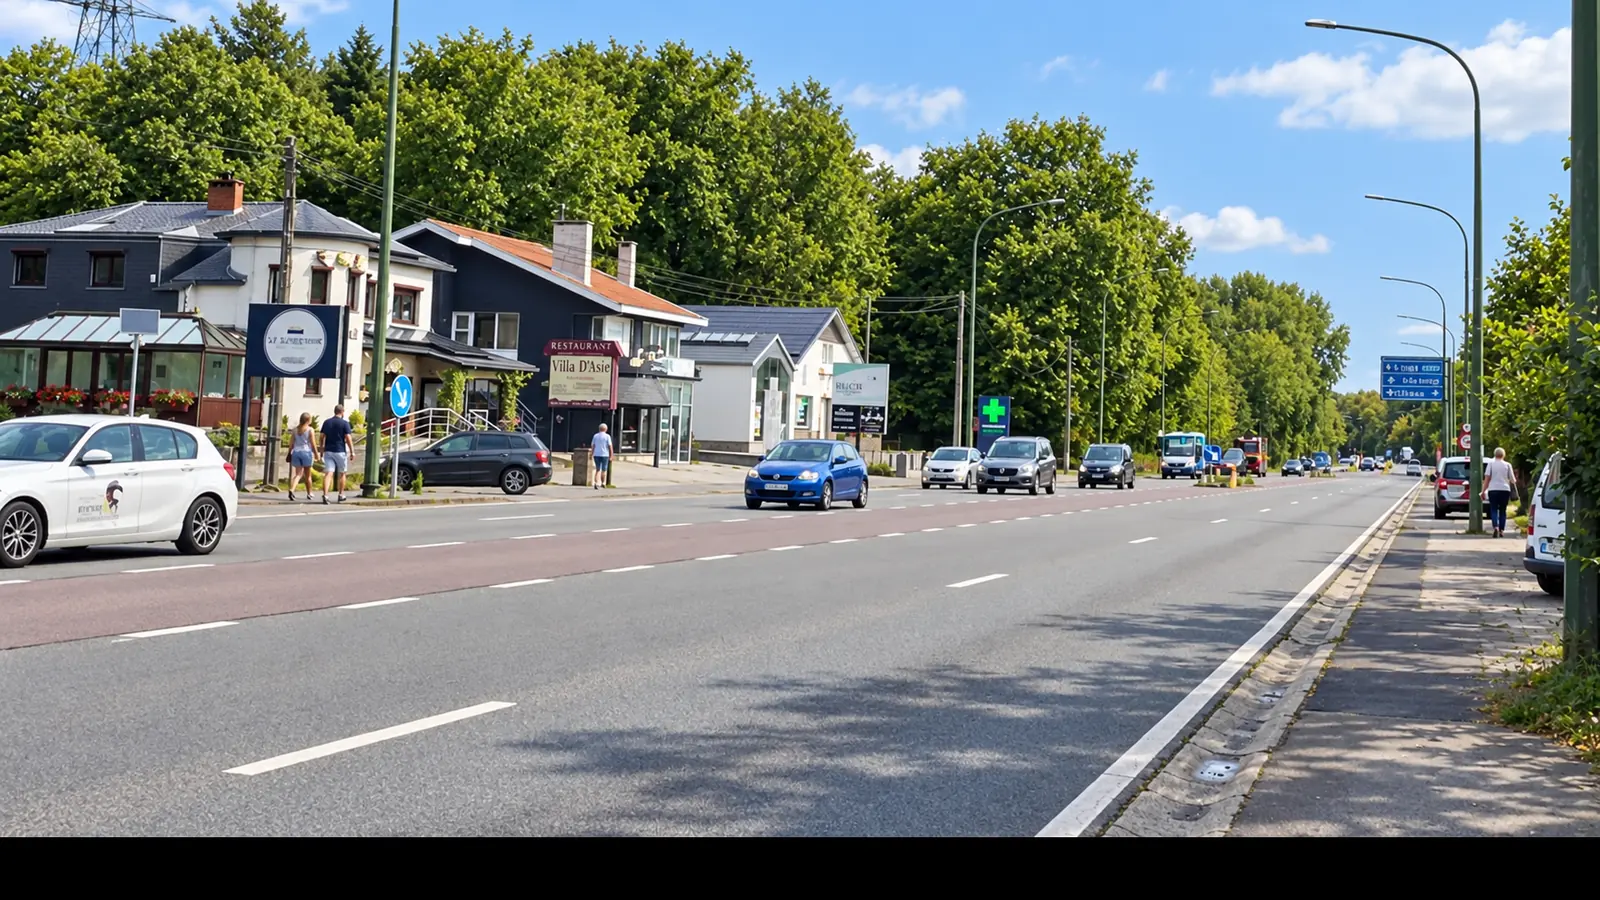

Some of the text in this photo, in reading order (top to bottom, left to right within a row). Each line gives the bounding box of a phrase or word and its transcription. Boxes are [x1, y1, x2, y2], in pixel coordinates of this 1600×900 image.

[551, 341, 612, 350] RESTAURANT
[552, 359, 610, 373] Villa D'Asie
